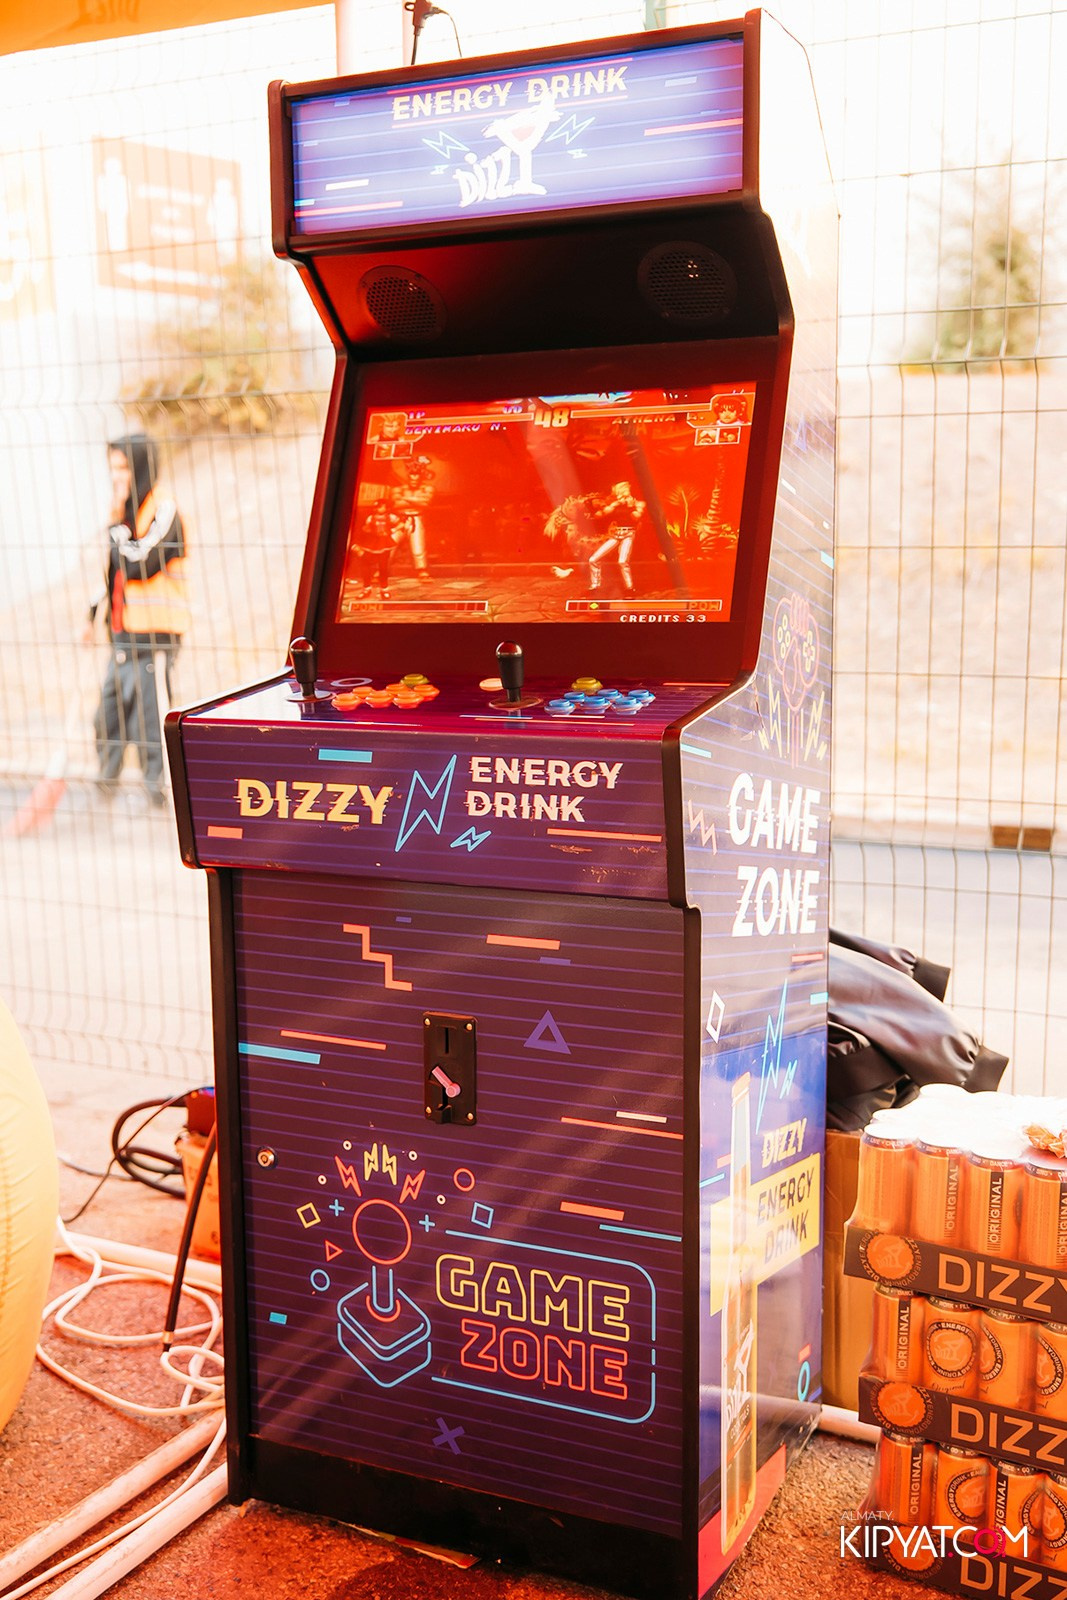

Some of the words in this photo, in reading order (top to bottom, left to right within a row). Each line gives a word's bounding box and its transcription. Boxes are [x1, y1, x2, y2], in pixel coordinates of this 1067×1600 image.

[392, 81, 512, 121] ENERGY
[525, 66, 629, 105] DRINK
[534, 407, 569, 428] 48
[620, 614, 679, 623] CREDITS
[686, 614, 707, 623] 33
[470, 756, 624, 789] ENERGY
[235, 778, 394, 825] DIZZY
[466, 790, 585, 822] DRINK
[727, 773, 820, 854] GAME
[731, 865, 820, 937] ZONE
[762, 1117, 807, 1168] DIZZY
[758, 1168, 815, 1226] ENERGY
[945, 1164, 959, 1230] ORIGINAL
[989, 1177, 1002, 1244] ORIGINAL
[765, 1209, 808, 1264] DRINK
[436, 1253, 630, 1342] GAME
[938, 1252, 1067, 1314] DIZZ
[898, 1306, 911, 1369] ORIGINAL
[1002, 1313, 1016, 1321] PLAY
[461, 1318, 628, 1400] ZONE
[909, 1452, 923, 1516] ORIGINAL
[960, 1552, 1067, 1600] DIZ
